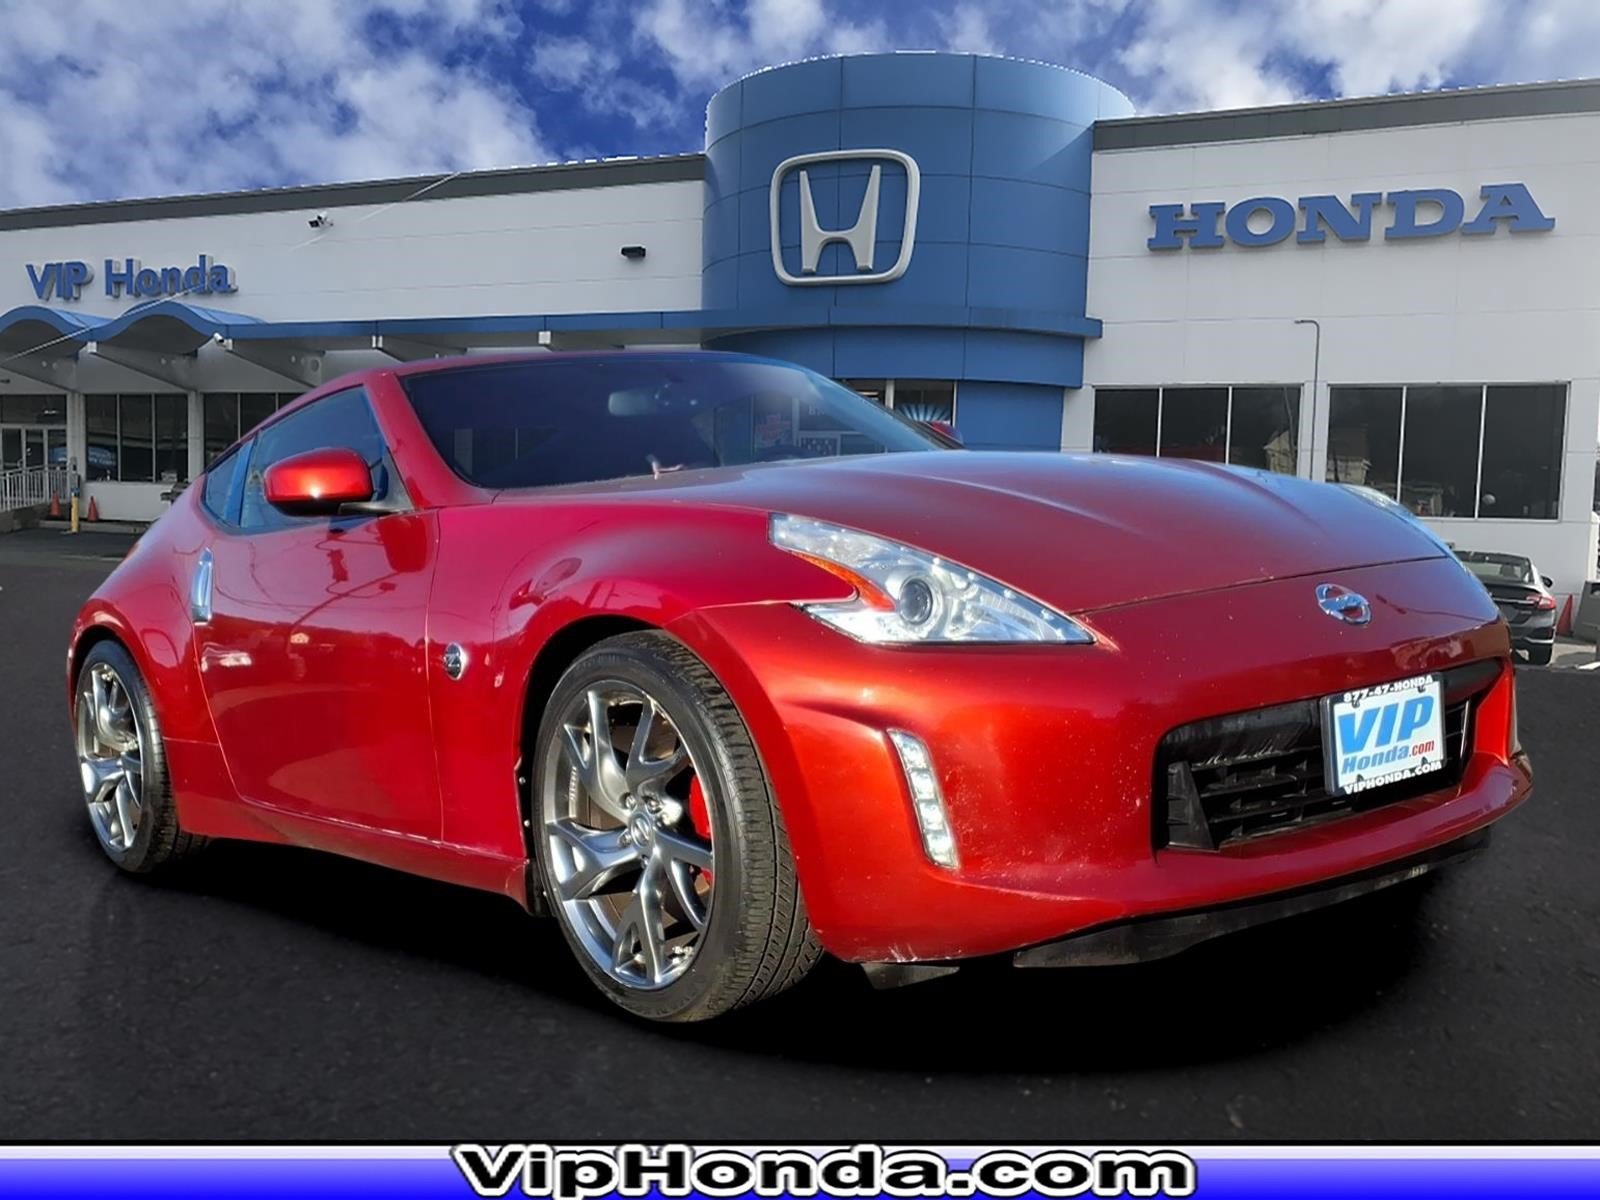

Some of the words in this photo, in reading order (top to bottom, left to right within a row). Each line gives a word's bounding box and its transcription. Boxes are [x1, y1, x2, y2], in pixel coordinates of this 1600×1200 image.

[1147, 183, 1556, 251] HONDA
[25, 260, 93, 301] VIP
[104, 253, 238, 298] Honda
[1338, 695, 1434, 756] VIP
[1341, 740, 1435, 775] Honda.com
[1343, 761, 1442, 795] VIPHONDA.COM
